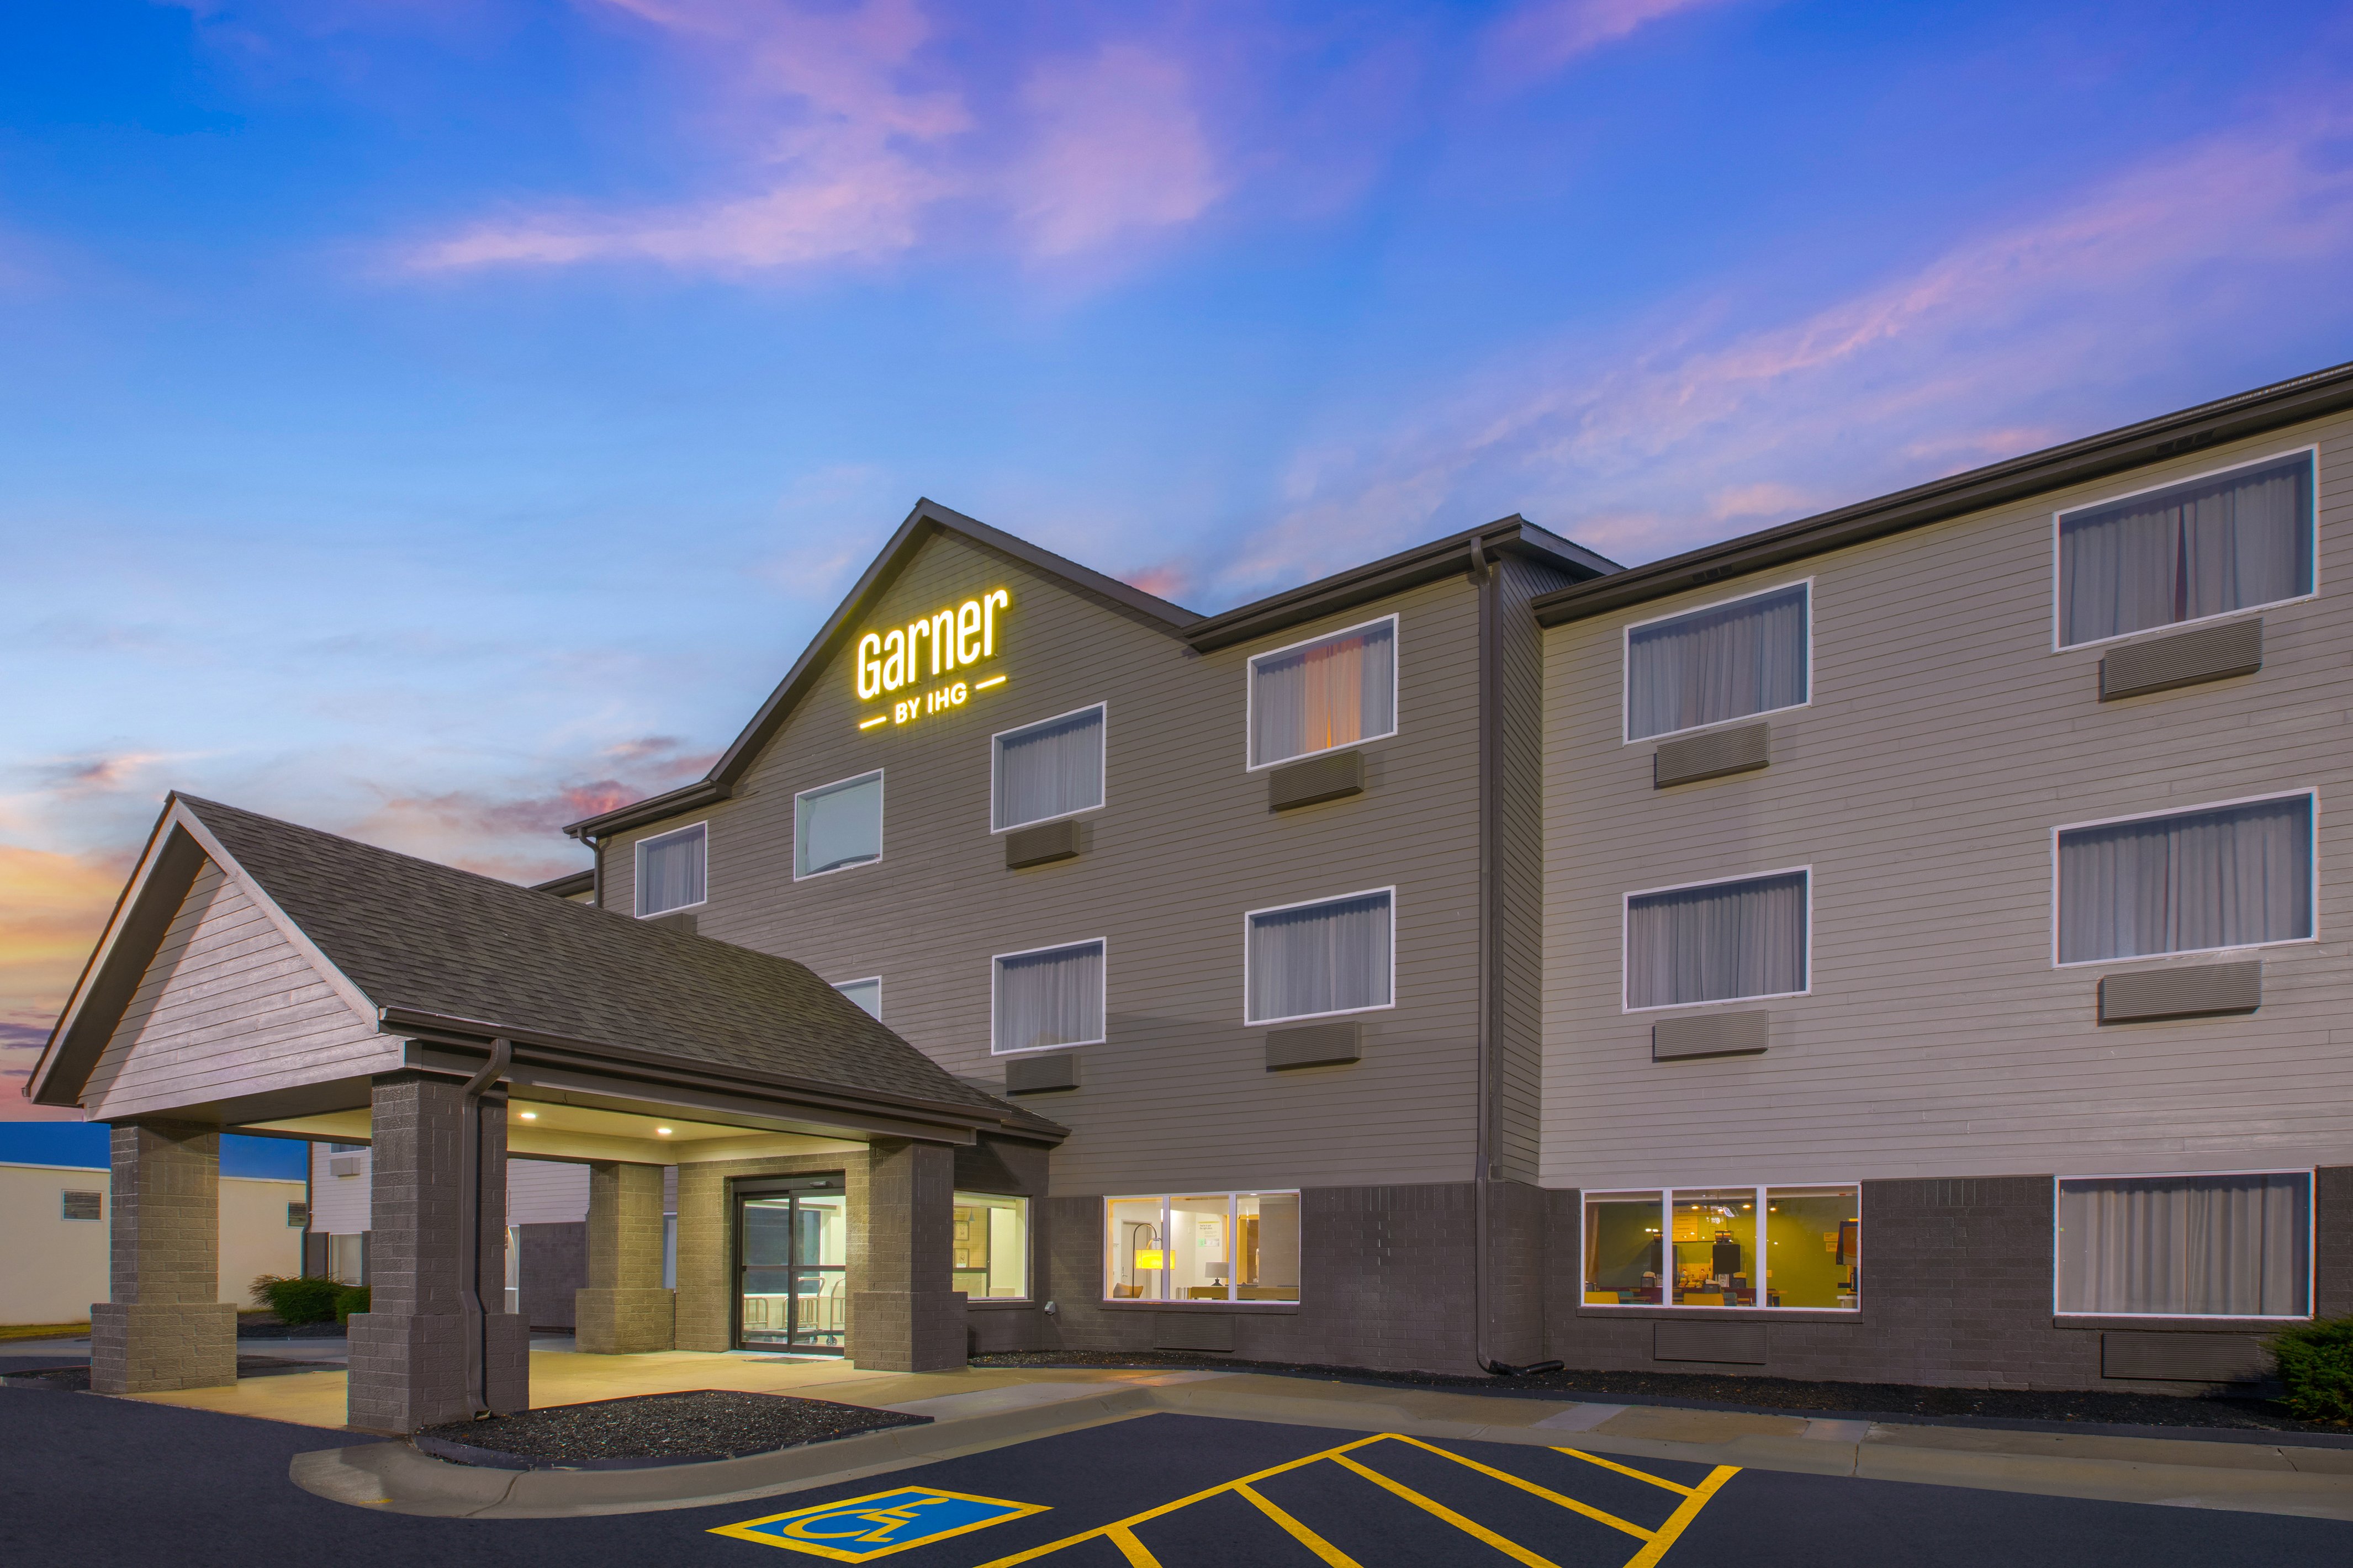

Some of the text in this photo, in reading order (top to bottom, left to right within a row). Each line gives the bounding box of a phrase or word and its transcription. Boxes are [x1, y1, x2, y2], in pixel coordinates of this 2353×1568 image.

[858, 590, 1008, 700] Garner
[895, 683, 967, 724] BY IHG
